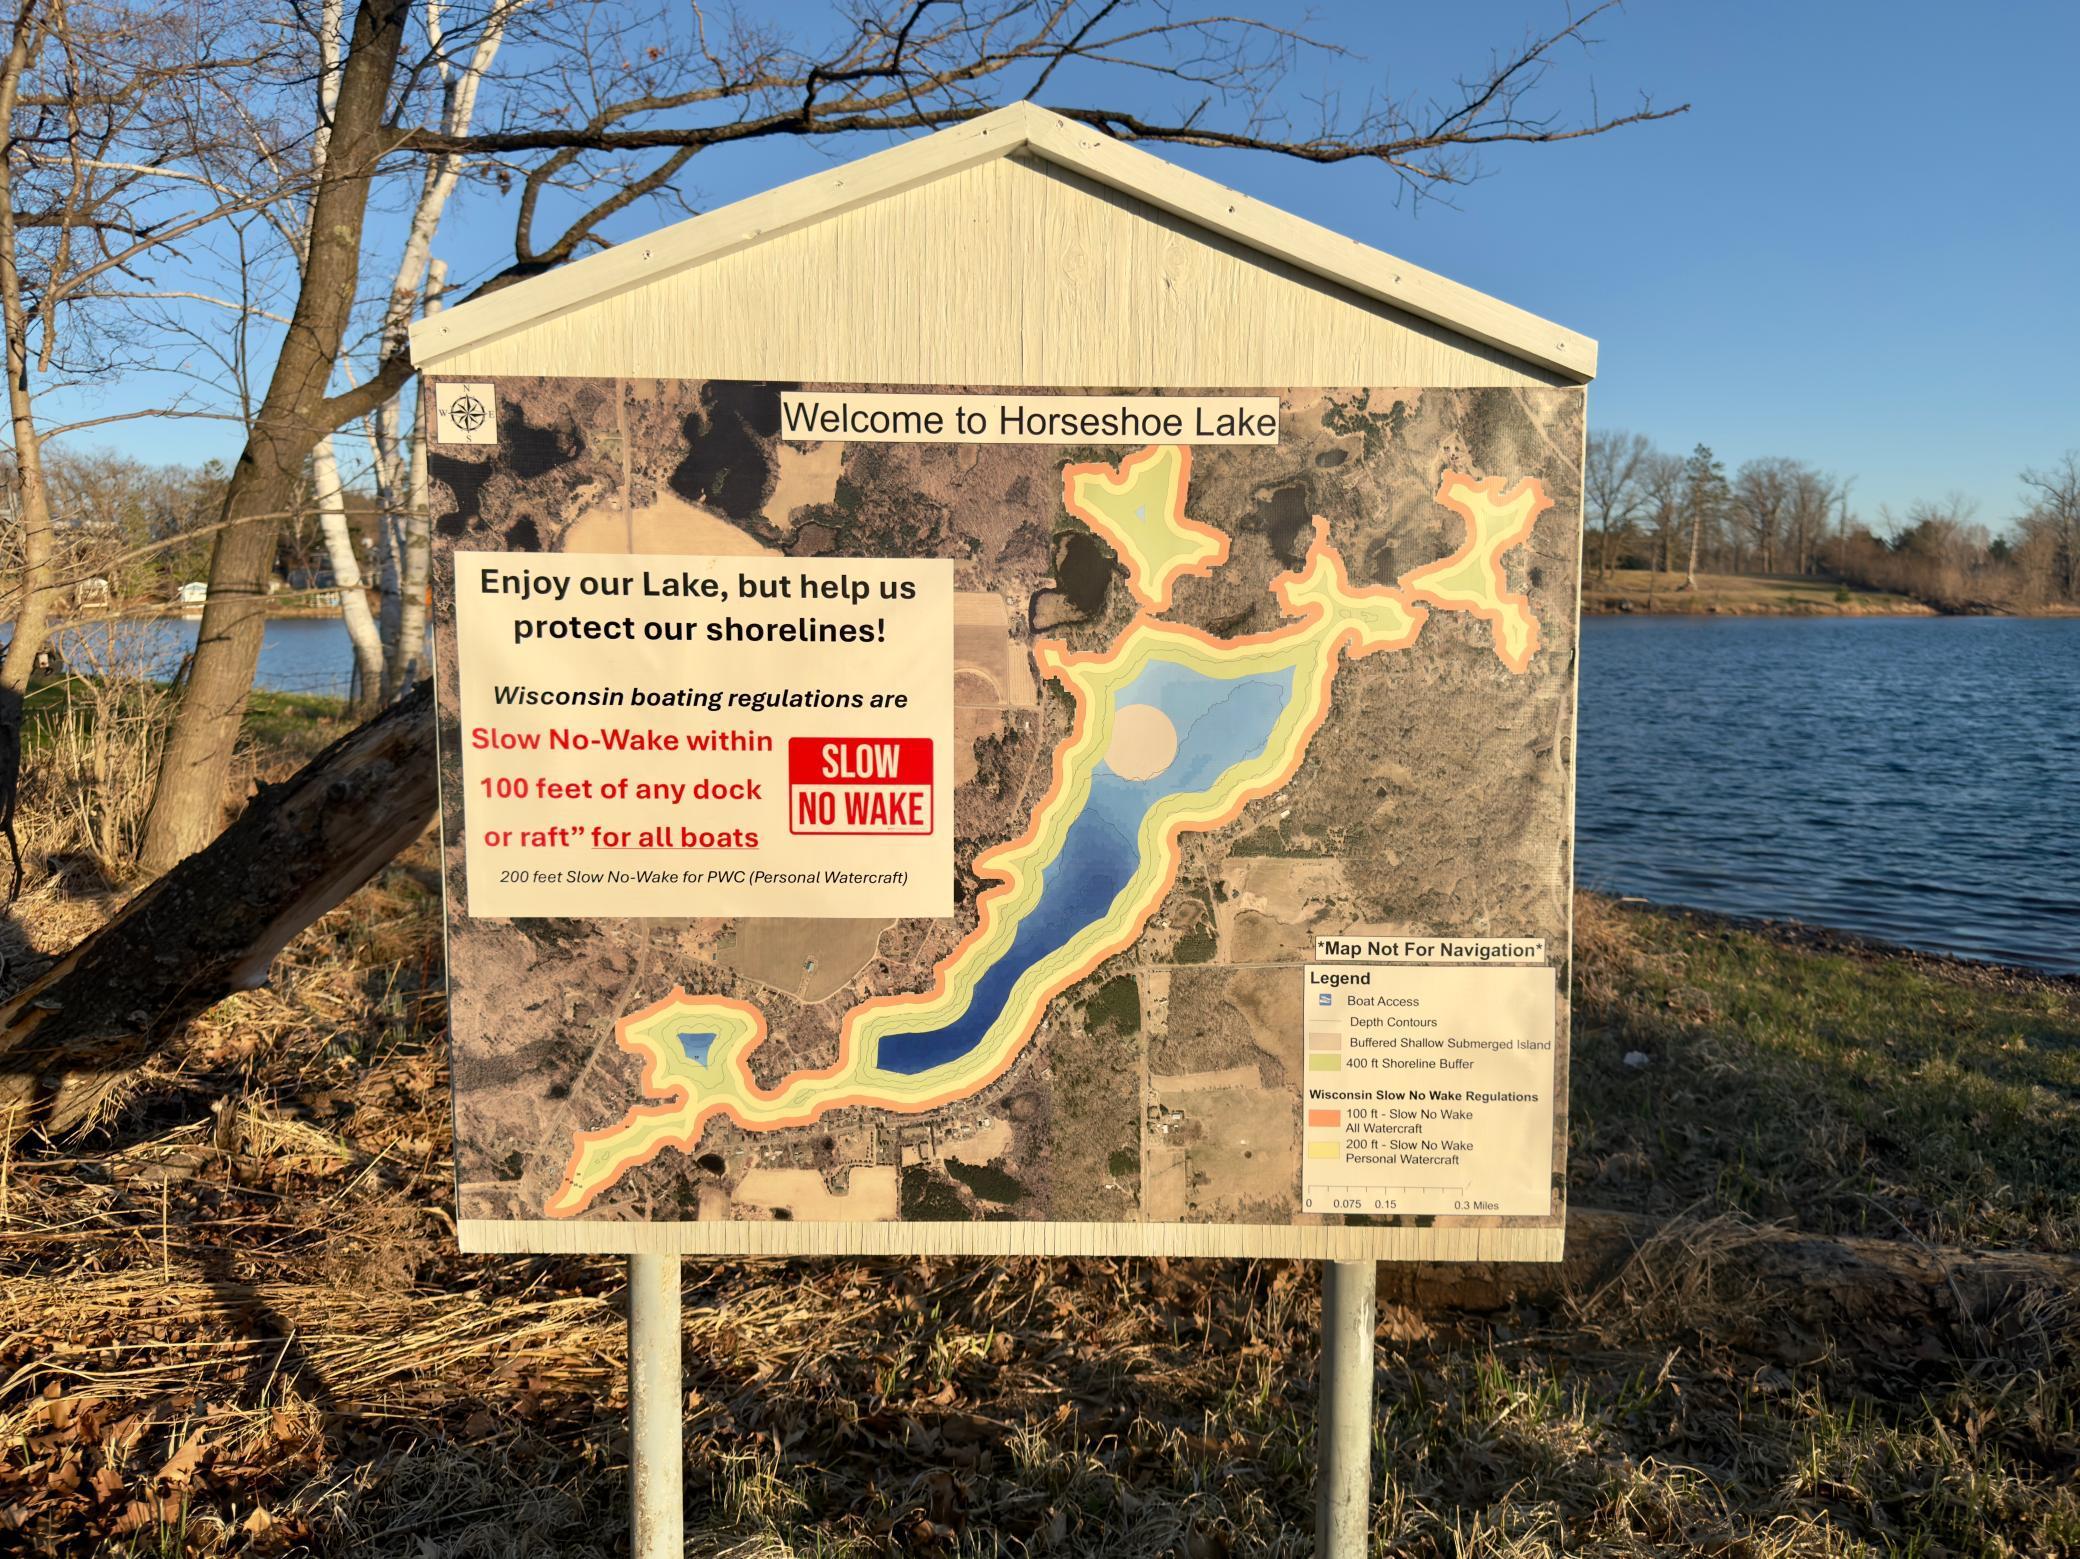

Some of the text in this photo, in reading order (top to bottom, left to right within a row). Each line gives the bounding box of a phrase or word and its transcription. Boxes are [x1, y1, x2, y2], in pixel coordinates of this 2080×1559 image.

[464, 383, 471, 392] N
[489, 409, 496, 418] E
[784, 402, 1278, 437] Welcome to Horseshoe Lake
[465, 435, 471, 444] S
[482, 569, 915, 605] Enjoy our Lake, but help us
[515, 617, 884, 644] protect our shorelines!
[495, 686, 907, 711] Wisconsin boating regulations are
[472, 728, 772, 751] Slow No-Wake within
[823, 744, 899, 778] SLOW
[481, 778, 762, 804] 100 feet of any dock
[799, 792, 923, 825] NO WAKE
[485, 831, 512, 846] or
[592, 826, 631, 848] for
[639, 826, 673, 848] all
[680, 826, 759, 848] boats
[500, 871, 907, 886] 200 feet Slow No-Wake for PWC (Personal Watercraft)
[1369, 942, 1398, 956] Not
[1405, 942, 1435, 956] For
[1311, 972, 1370, 987] Legend
[1348, 996, 1419, 1006] Boat Access
[1351, 1017, 1437, 1029] Depth Contours
[1351, 1038, 1551, 1051] Buffered Shallow Submerged Island
[1346, 1058, 1474, 1069] 400 ft Shoreline Buffer
[1310, 1090, 1538, 1103] Wisconsin Slow No Wake Regulations
[1347, 1109, 1367, 1118] 100
[1371, 1109, 1377, 1118] ft
[1390, 1109, 1417, 1119] Slow
[1421, 1109, 1437, 1119] No
[1441, 1110, 1472, 1119] Wake
[1346, 1123, 1422, 1133] All Watercraft
[1346, 1139, 1367, 1149] 200
[1371, 1140, 1378, 1149] ft
[1390, 1140, 1417, 1149] Slow
[1422, 1141, 1437, 1150] No
[1441, 1141, 1473, 1150] Wake
[1346, 1153, 1459, 1165] Personal Watercraft
[1306, 1199, 1499, 1210] 0 0.075 0.15 0.3 Miles
